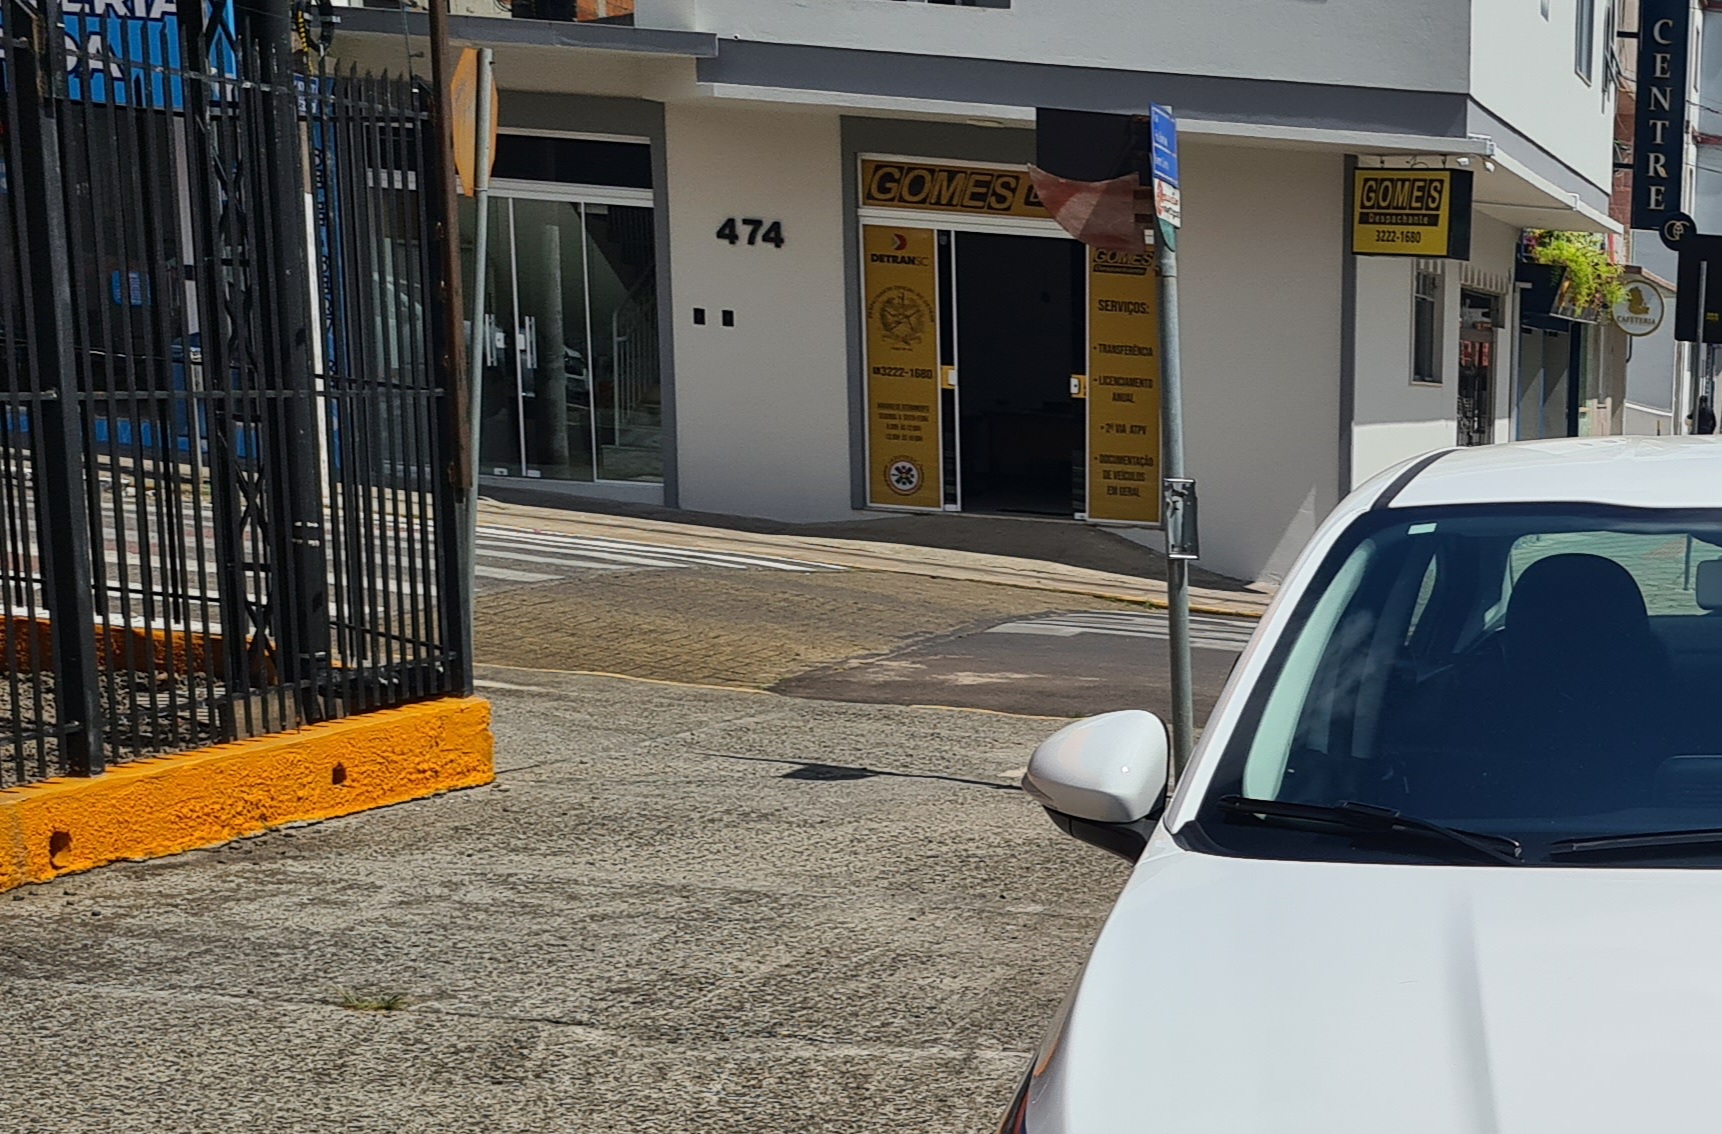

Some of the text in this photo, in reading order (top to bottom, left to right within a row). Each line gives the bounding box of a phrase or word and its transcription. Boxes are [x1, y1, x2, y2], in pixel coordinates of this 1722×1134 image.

[1647, 18, 1674, 211] CENTRE
[870, 166, 1020, 211] GOMES
[1362, 180, 1441, 208] GOMES
[716, 217, 785, 248] 474
[1368, 213, 1429, 224] Despachante
[1375, 230, 1422, 244] 3222-1680
[1098, 299, 1150, 315] SERVIÇOS:
